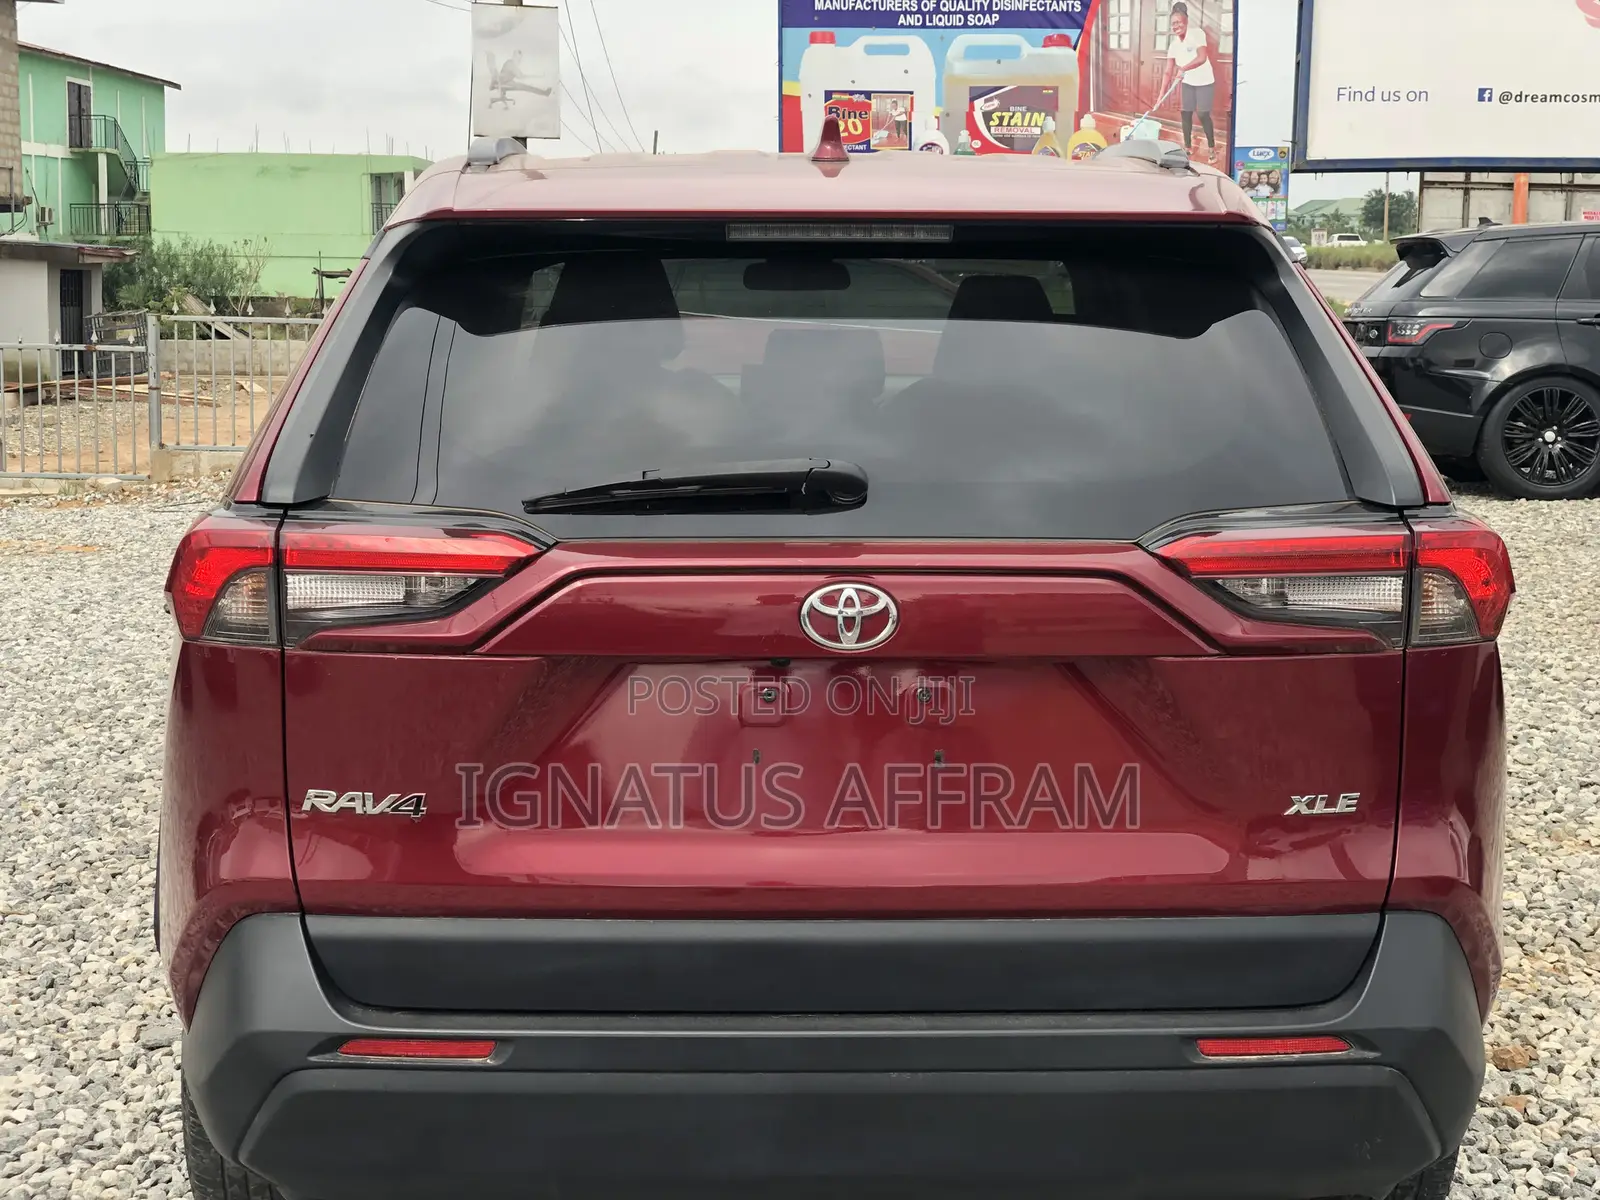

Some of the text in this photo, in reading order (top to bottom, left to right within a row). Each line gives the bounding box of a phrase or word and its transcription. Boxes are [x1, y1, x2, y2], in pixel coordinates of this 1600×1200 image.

[814, 0, 1082, 13] MANUFACTURERS OF QUALITY DISINFECTANTS
[897, 14, 1000, 27] AND LIQUID SOAP
[1337, 86, 1429, 102] Find us on
[828, 105, 869, 120] Bine
[988, 111, 1046, 127] STAIN
[301, 788, 428, 818] RAV4
[1283, 792, 1361, 815] XLE
